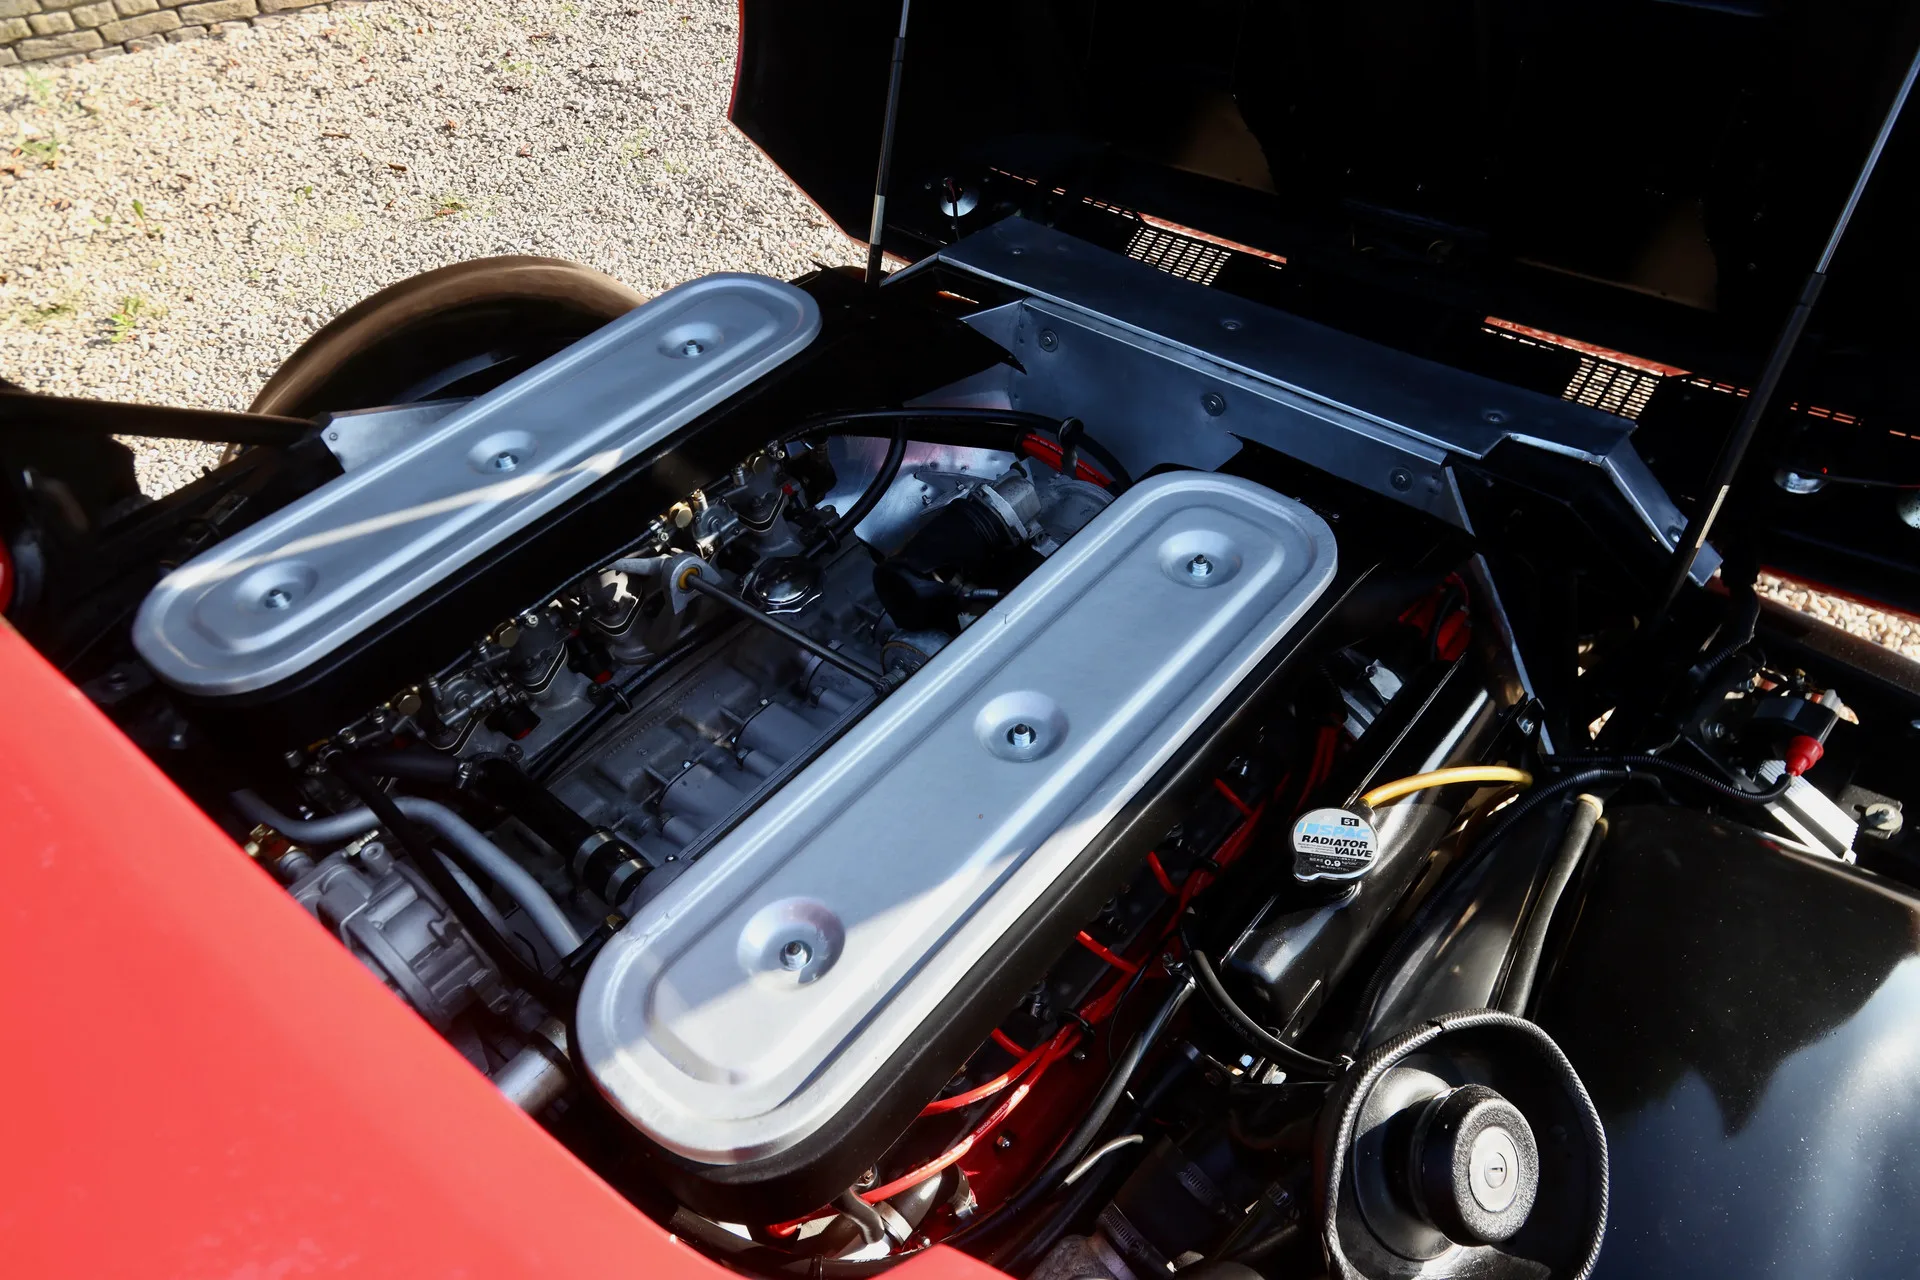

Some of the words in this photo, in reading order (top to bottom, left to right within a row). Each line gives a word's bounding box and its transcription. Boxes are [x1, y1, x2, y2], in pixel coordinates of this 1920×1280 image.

[1302, 835, 1368, 849] RADIATOR
[1334, 847, 1373, 858] VALVE
[1324, 859, 1341, 867] 0.9
